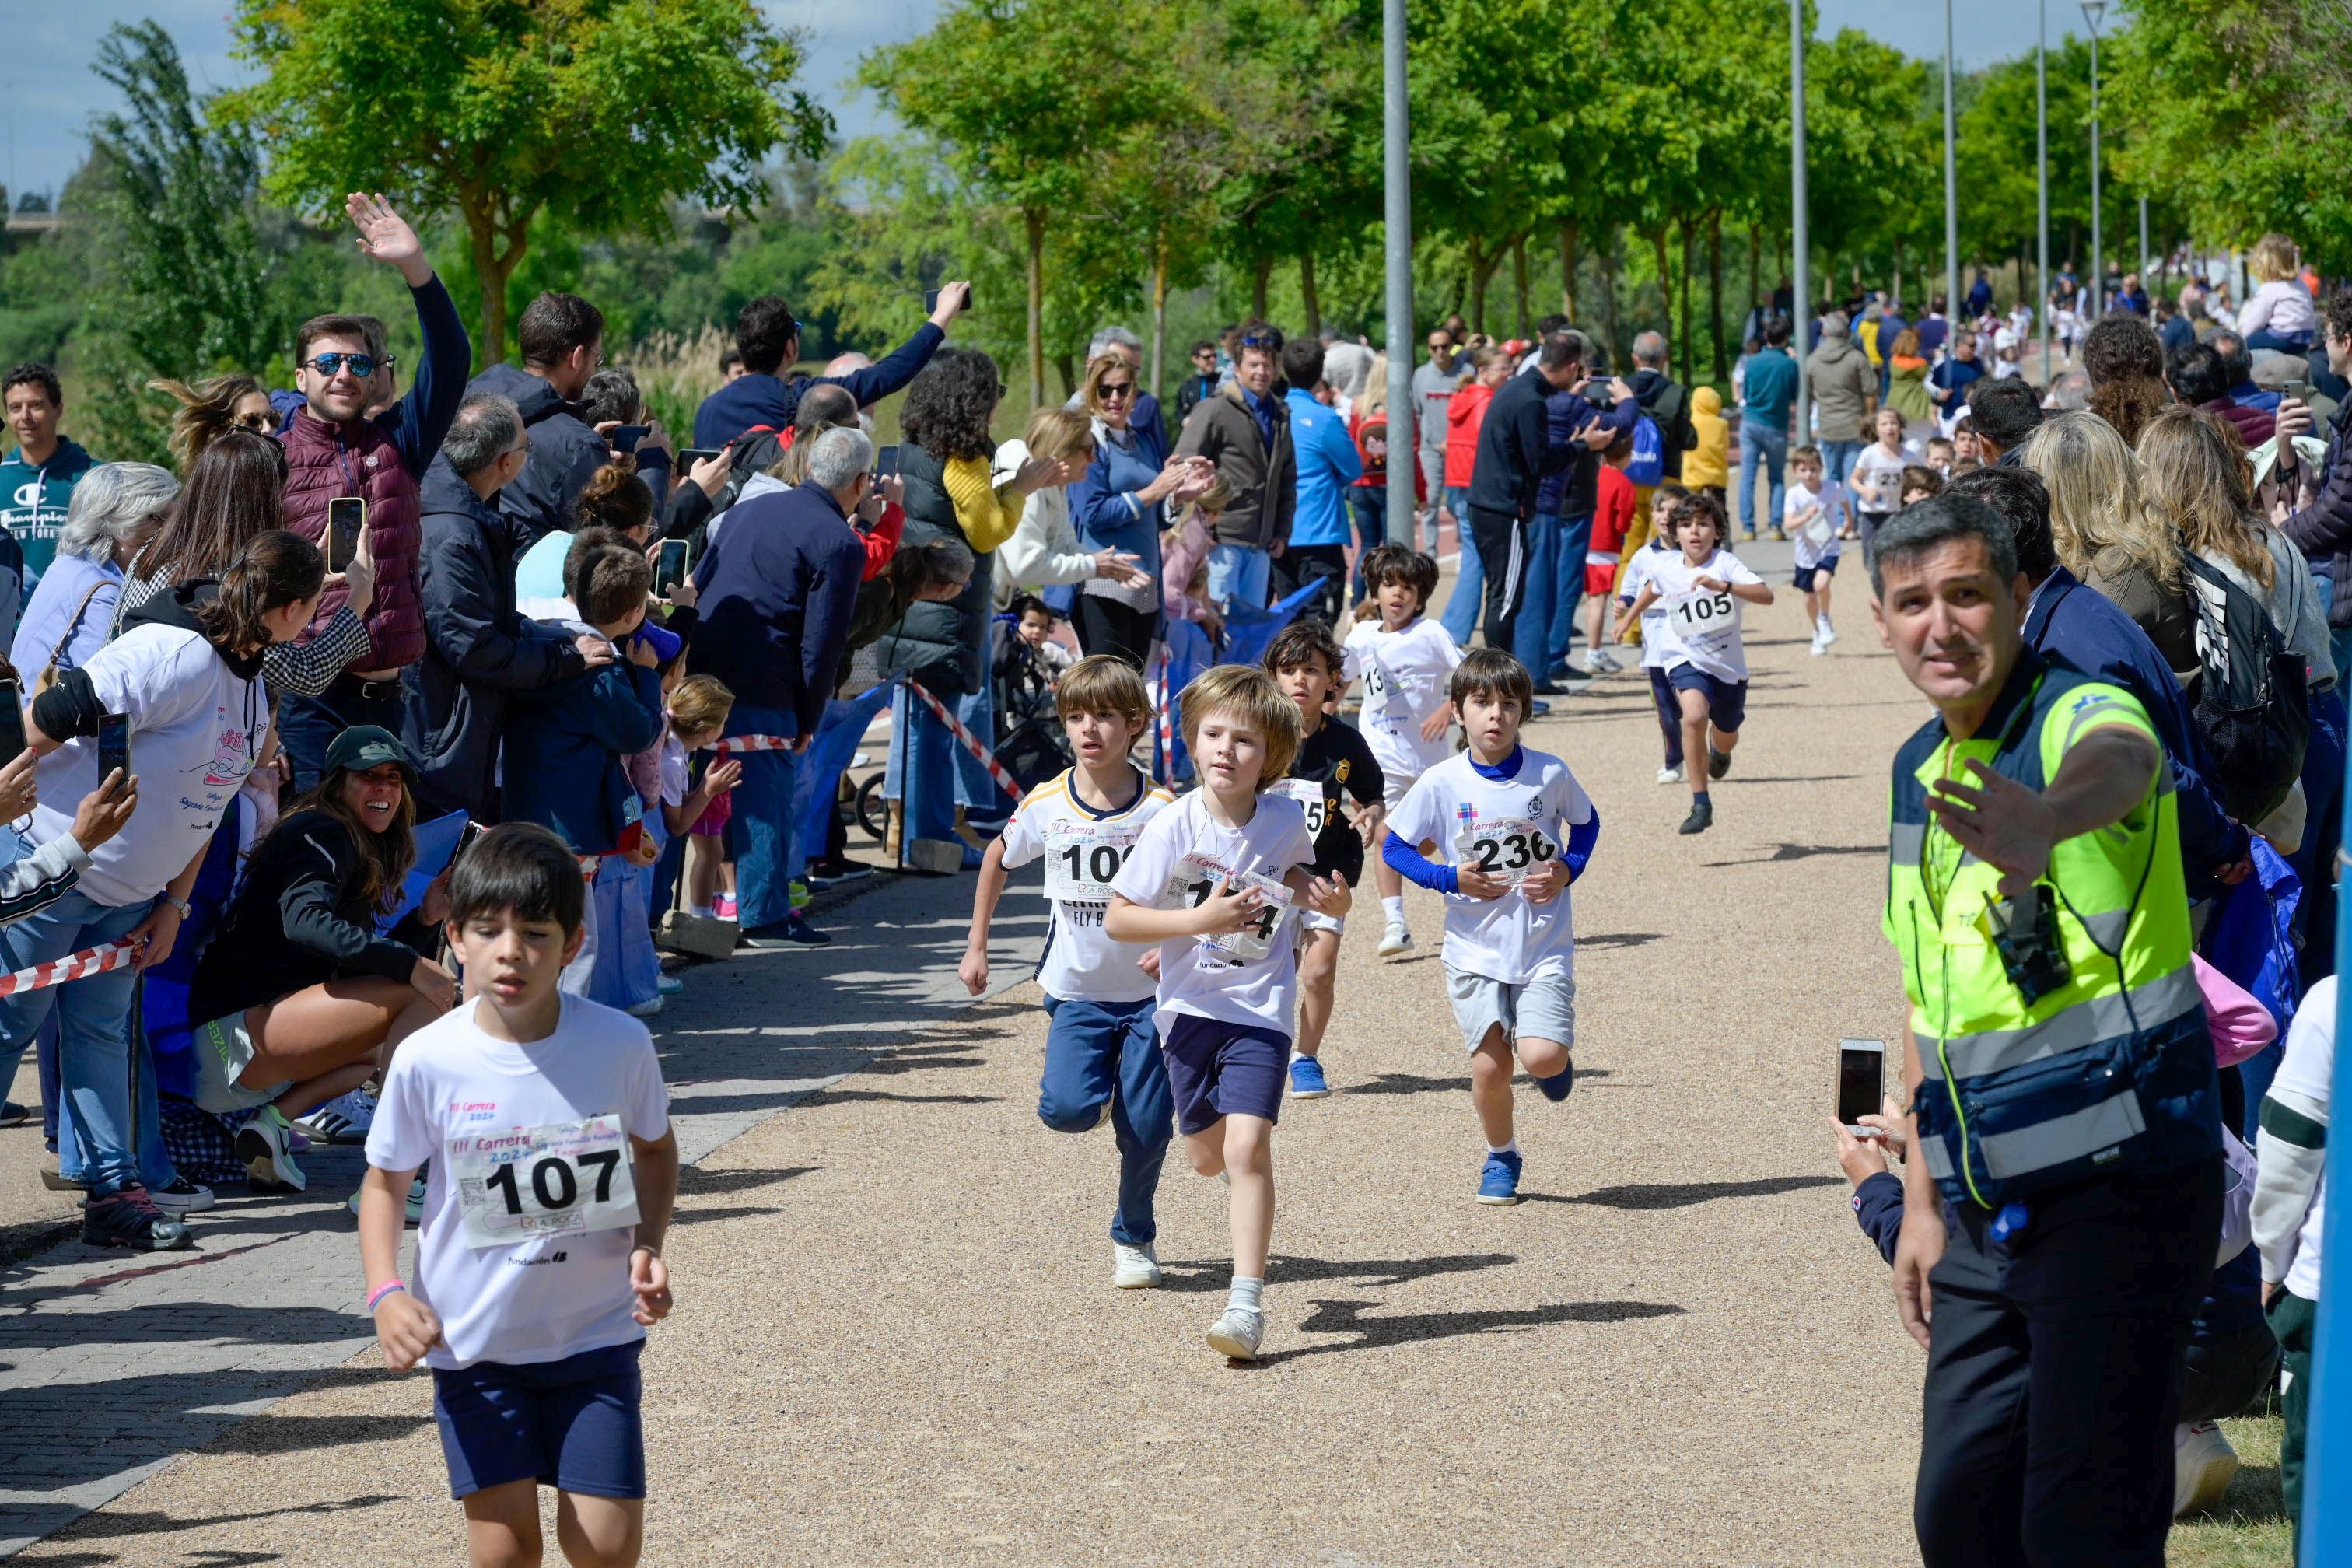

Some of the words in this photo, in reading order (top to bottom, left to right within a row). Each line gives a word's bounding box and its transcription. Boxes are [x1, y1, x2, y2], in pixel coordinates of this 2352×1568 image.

[10, 529, 26, 540] EW
[34, 529, 54, 539] ORK
[1678, 592, 1732, 623] 105
[1294, 799, 1323, 832] 5
[1064, 825, 1095, 835] Carrera
[1470, 821, 1506, 831] Carrera
[1479, 830, 1504, 839] 2024
[1473, 831, 1555, 872] 236
[1062, 845, 1135, 883] 10
[1196, 858, 1239, 877] Carrera
[1199, 869, 1223, 882] 202
[1187, 879, 1279, 940] 14
[1074, 911, 1092, 927] FLY
[1096, 911, 1106, 927] B
[450, 1102, 460, 1111] III
[463, 1101, 495, 1111] Carrera
[470, 1112, 495, 1121] 2024
[453, 1140, 469, 1153] III
[476, 1136, 530, 1150] Carrera
[490, 1148, 533, 1164] 2024
[487, 1149, 621, 1214] 107
[551, 1213, 581, 1228] ROCA
